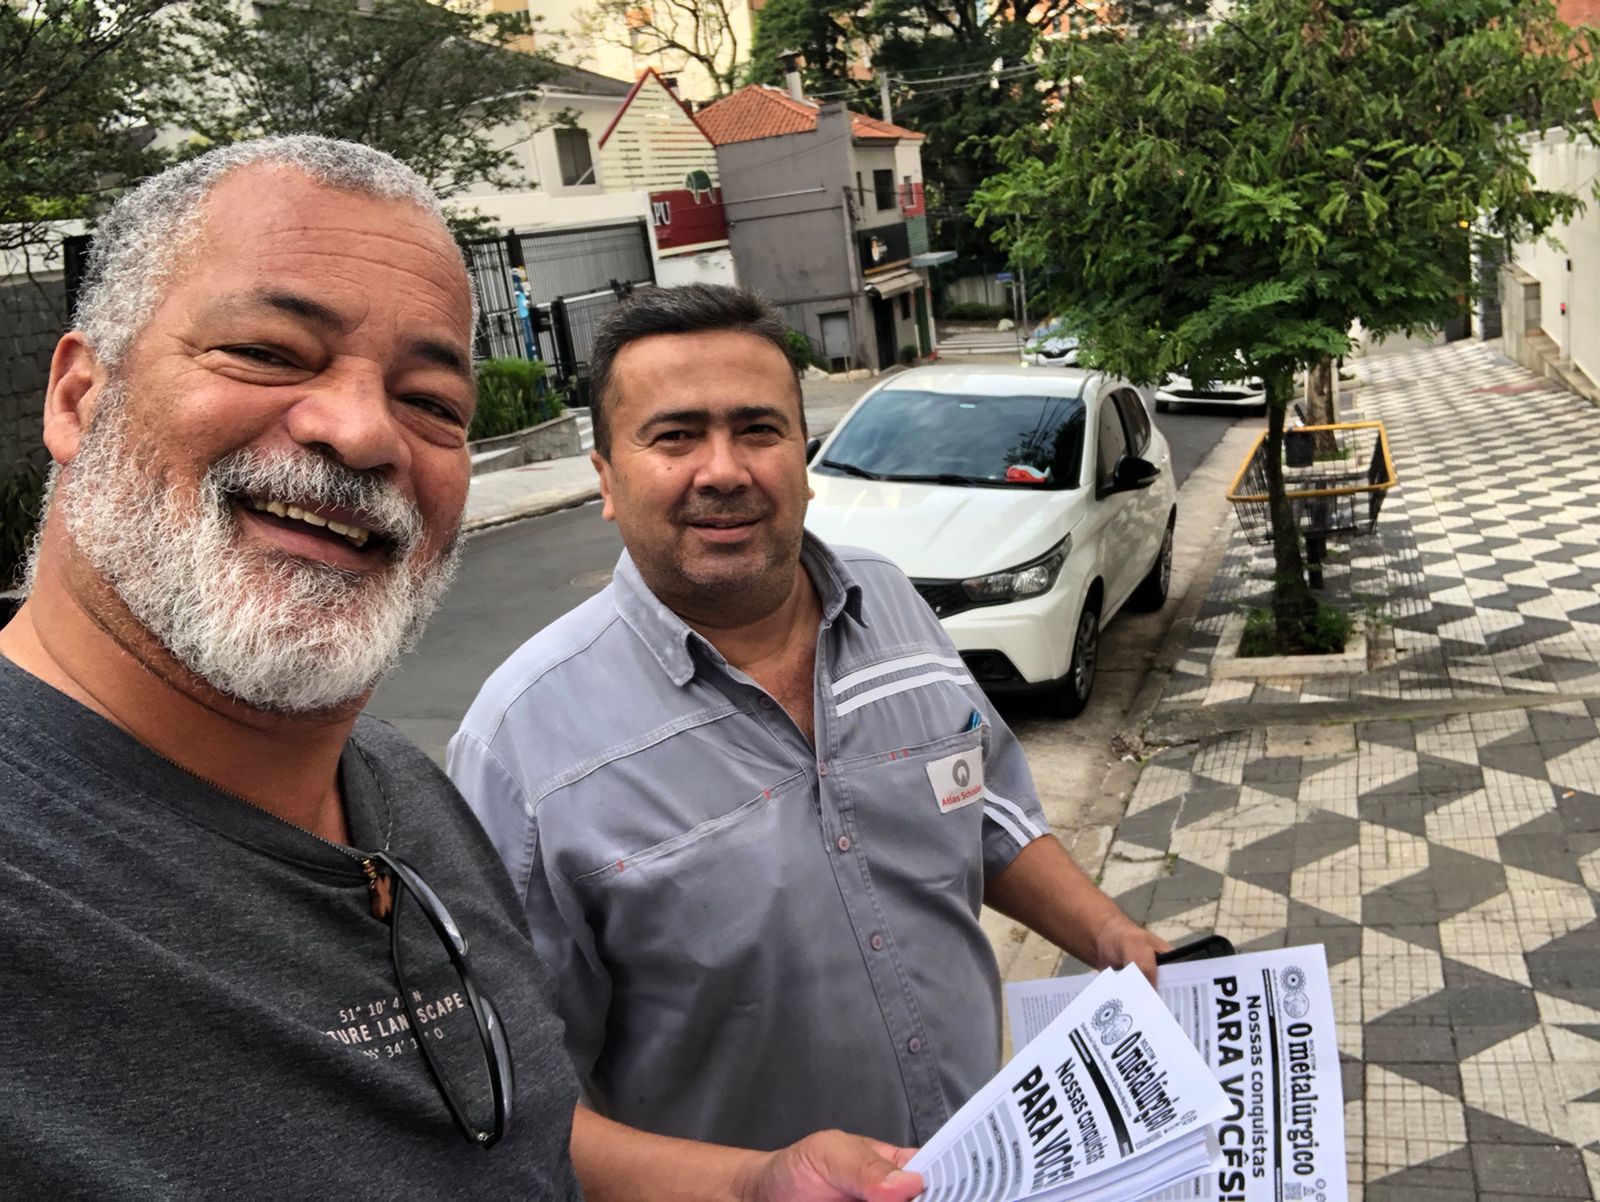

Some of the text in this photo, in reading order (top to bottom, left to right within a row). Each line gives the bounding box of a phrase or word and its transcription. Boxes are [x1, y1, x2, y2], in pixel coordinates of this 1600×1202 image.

[942, 795, 960, 807] Atlas
[326, 992, 465, 1045] TURE LANSCAPE
[1111, 1031, 1142, 1059] O
[1213, 976, 1244, 1067] PARA
[1287, 1023, 1312, 1037] O
[1012, 1064, 1064, 1147] PARA
[1055, 1057, 1088, 1115] Nossas
[1076, 1110, 1108, 1165] conquistas
[1115, 1046, 1180, 1132] metalúrgico
[1246, 995, 1268, 1177] Nossas conquistas
[1287, 1041, 1319, 1175] metalúrgico
